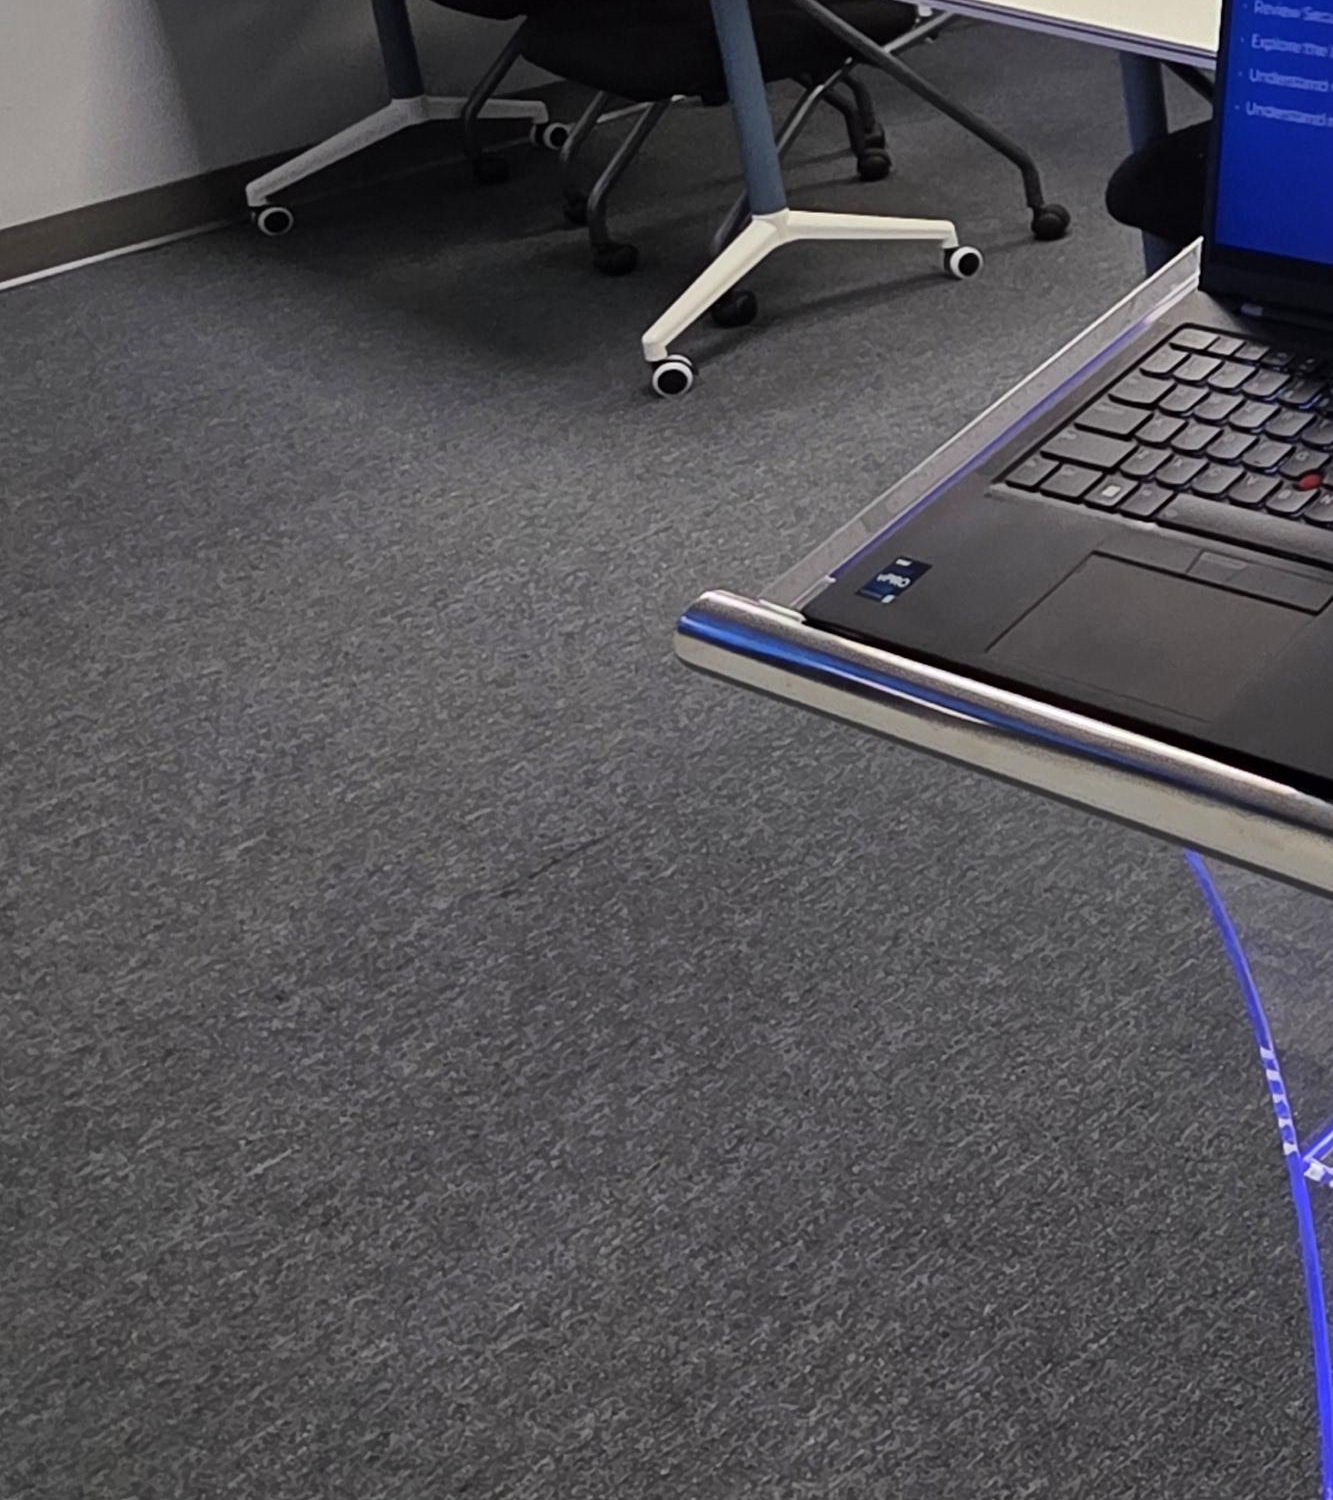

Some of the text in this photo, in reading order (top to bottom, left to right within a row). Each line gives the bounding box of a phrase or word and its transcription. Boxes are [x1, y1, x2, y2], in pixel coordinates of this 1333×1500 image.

[1253, 0, 1302, 19] Review
[1251, 33, 1301, 55] Explore
[1304, 41, 1328, 58] the
[1249, 68, 1329, 93] Understand
[1245, 101, 1327, 127] Understand
